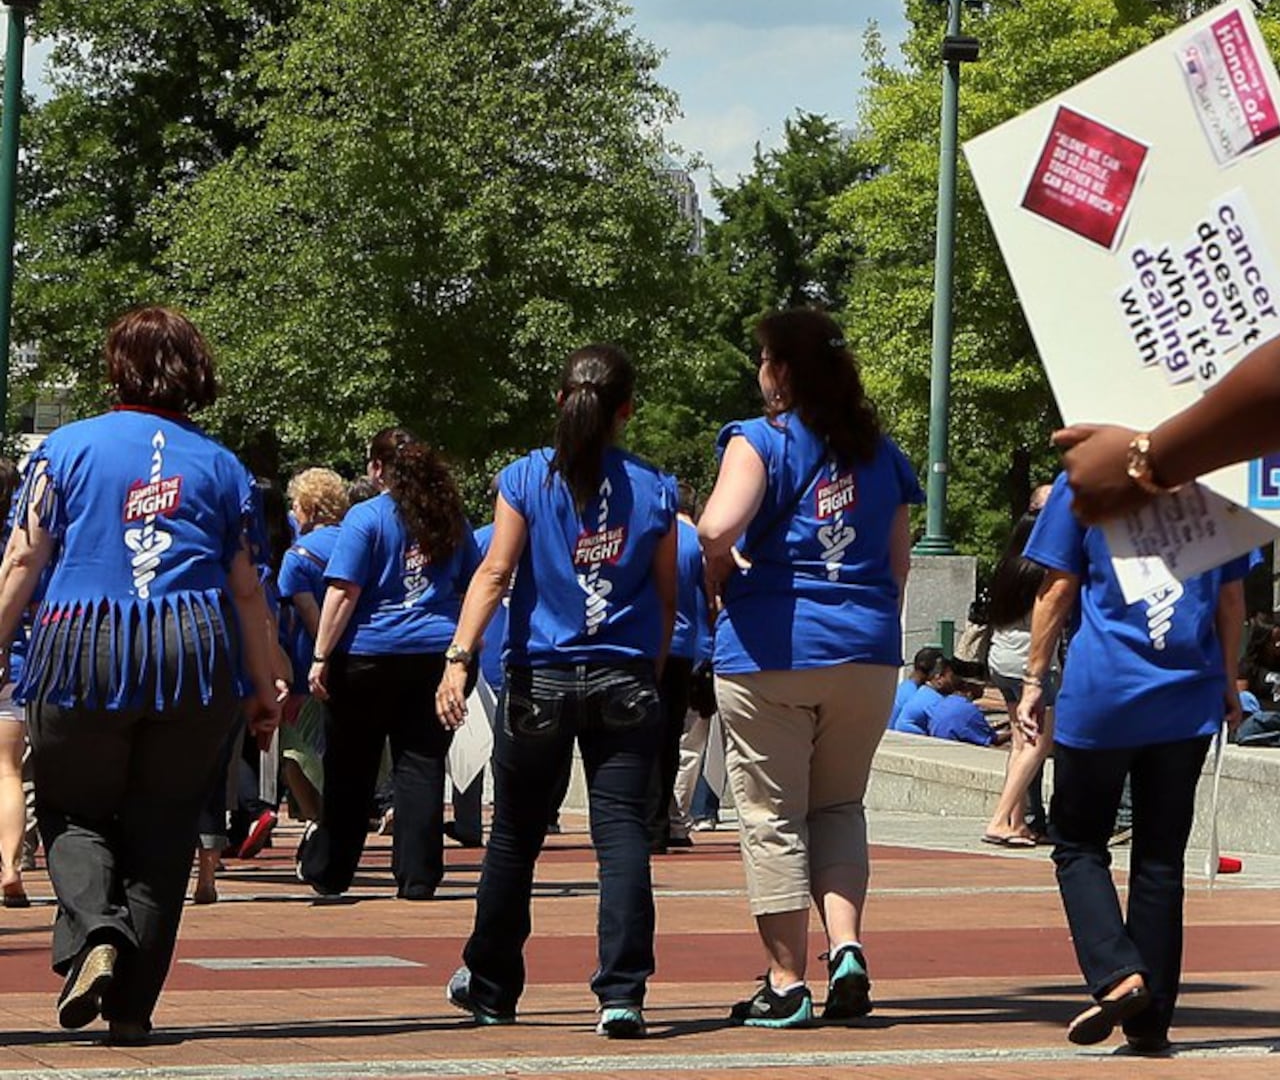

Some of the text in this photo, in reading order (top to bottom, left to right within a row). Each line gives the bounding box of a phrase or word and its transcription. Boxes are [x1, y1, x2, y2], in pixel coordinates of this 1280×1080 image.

[1216, 24, 1250, 93] Honor
[1184, 244, 1233, 337] know
[1197, 221, 1262, 346] doesn't
[1218, 204, 1278, 319] cancer
[1119, 287, 1160, 363] with
[1131, 248, 1190, 373] dealing
[1156, 247, 1218, 380] who it's
[126, 489, 178, 520] FIGHT
[818, 484, 855, 518] FIGHT
[574, 538, 623, 566] FIGHT
